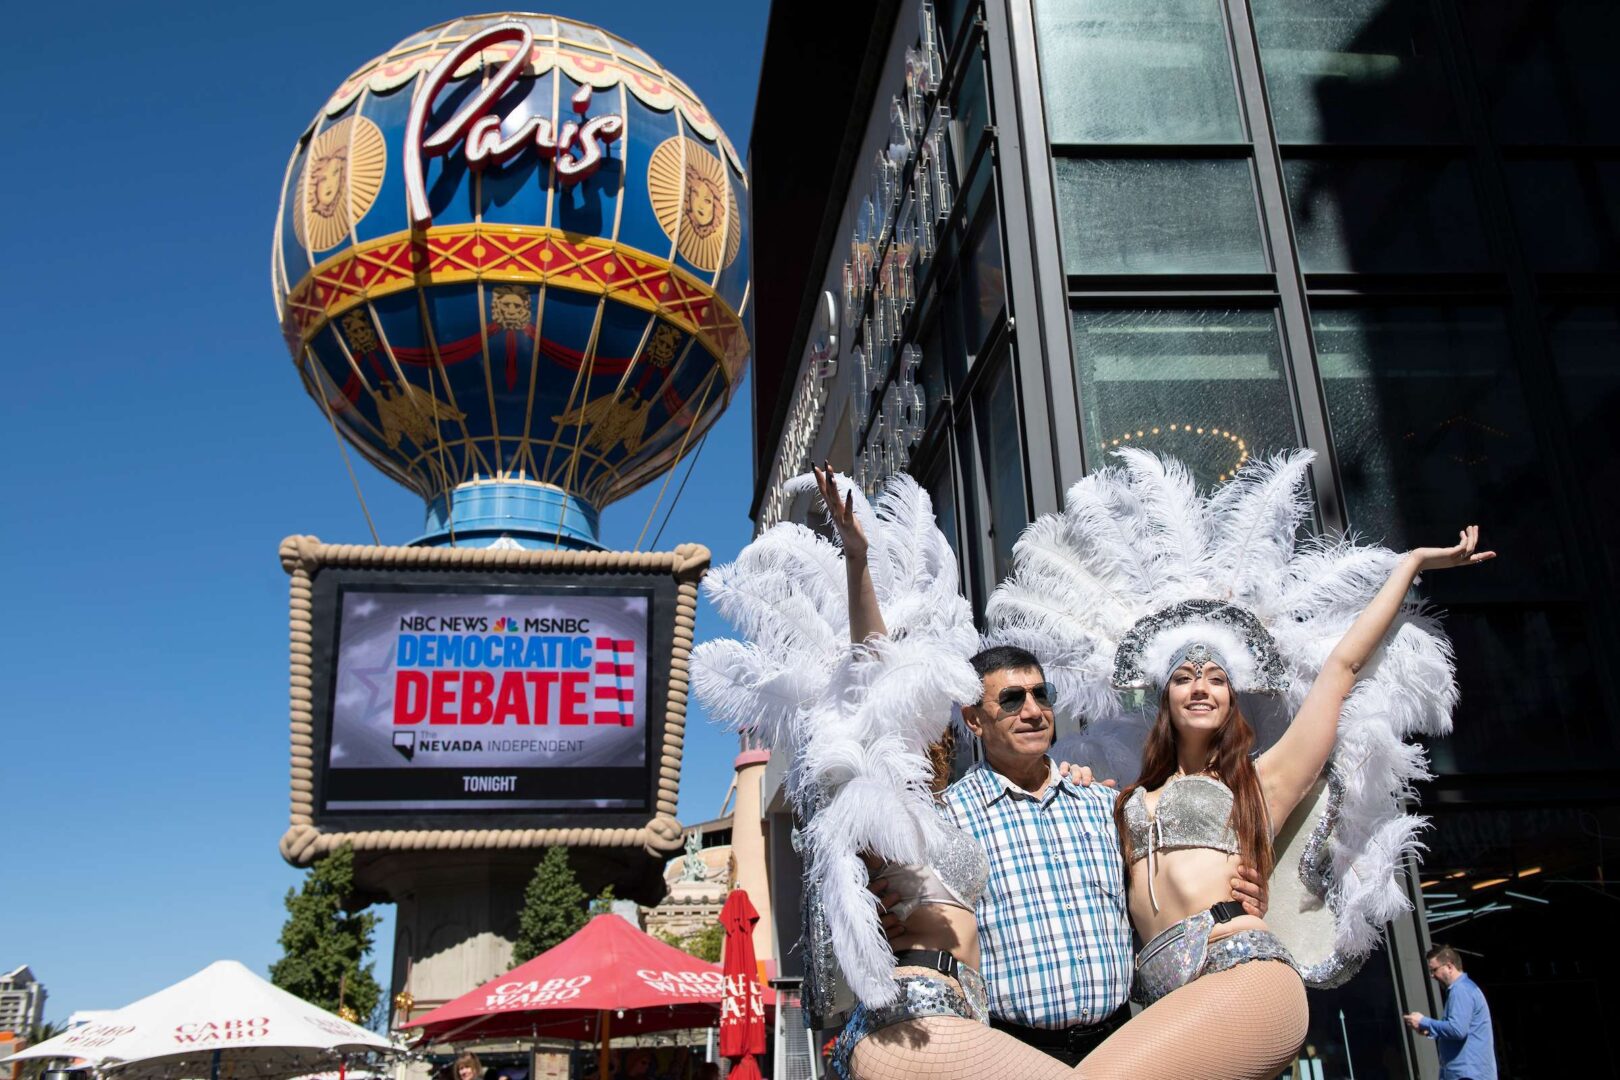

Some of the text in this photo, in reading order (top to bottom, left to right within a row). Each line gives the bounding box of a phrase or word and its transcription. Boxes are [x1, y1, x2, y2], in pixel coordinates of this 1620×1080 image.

[404, 19, 622, 228] Paris
[400, 616, 590, 633] NBC NEWS MSNBC
[397, 634, 592, 668] DEMOCRATIC
[393, 670, 590, 725] DEBATE
[420, 730, 438, 740] The
[419, 739, 585, 752] NEVADA INDEPENDENT
[462, 776, 517, 792] TONIGHT
[495, 975, 592, 994] CABO
[636, 969, 723, 984] CABO
[485, 988, 581, 1007] WABO
[176, 1017, 270, 1032] CABO
[174, 1028, 269, 1043] WABO
